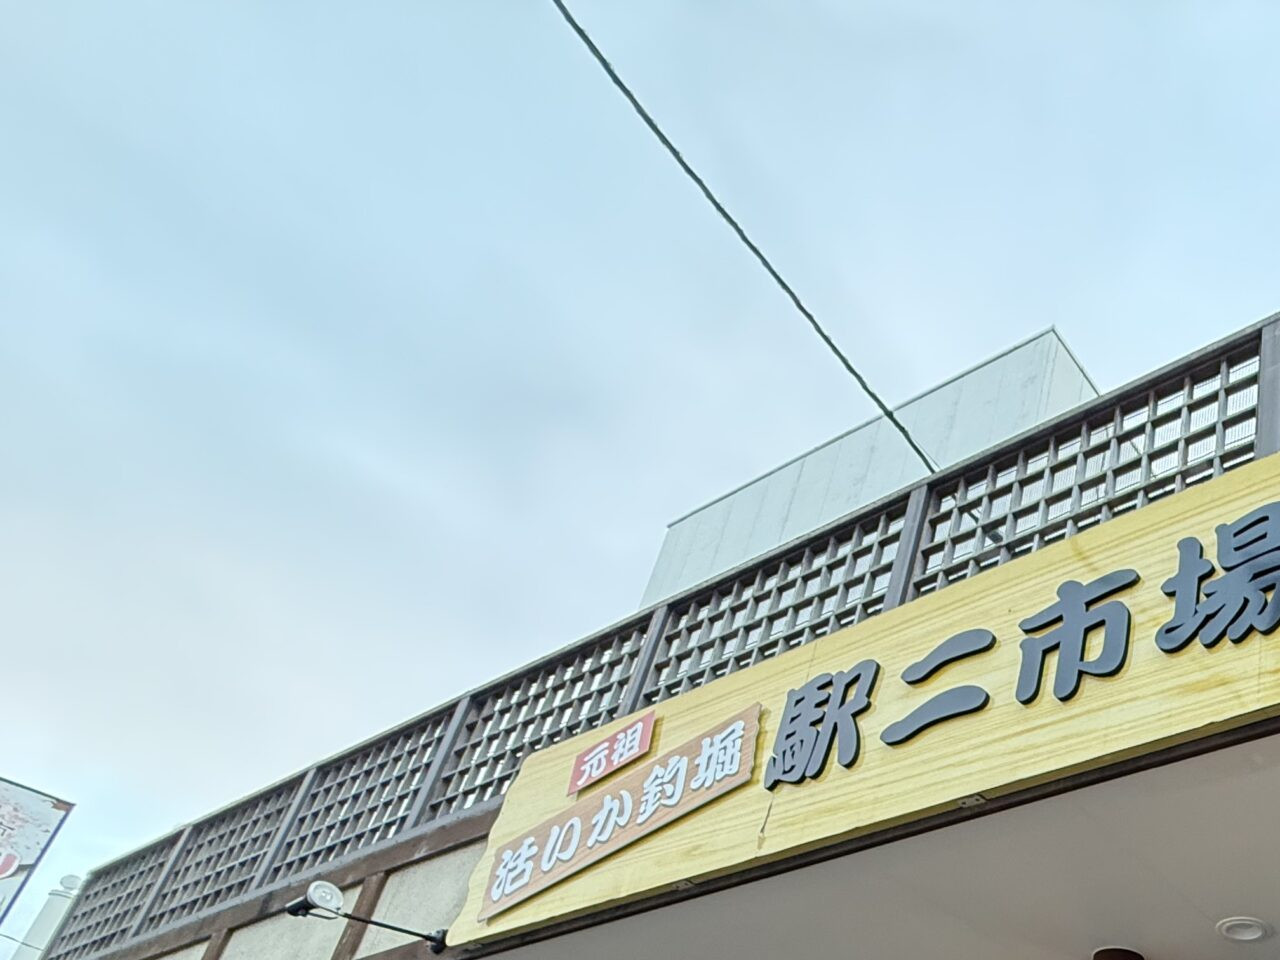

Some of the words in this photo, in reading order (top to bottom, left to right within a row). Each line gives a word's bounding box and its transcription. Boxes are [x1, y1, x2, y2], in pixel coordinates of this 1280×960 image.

[490, 719, 746, 902] 活いか釣堀
[576, 721, 645, 786] 元祖
